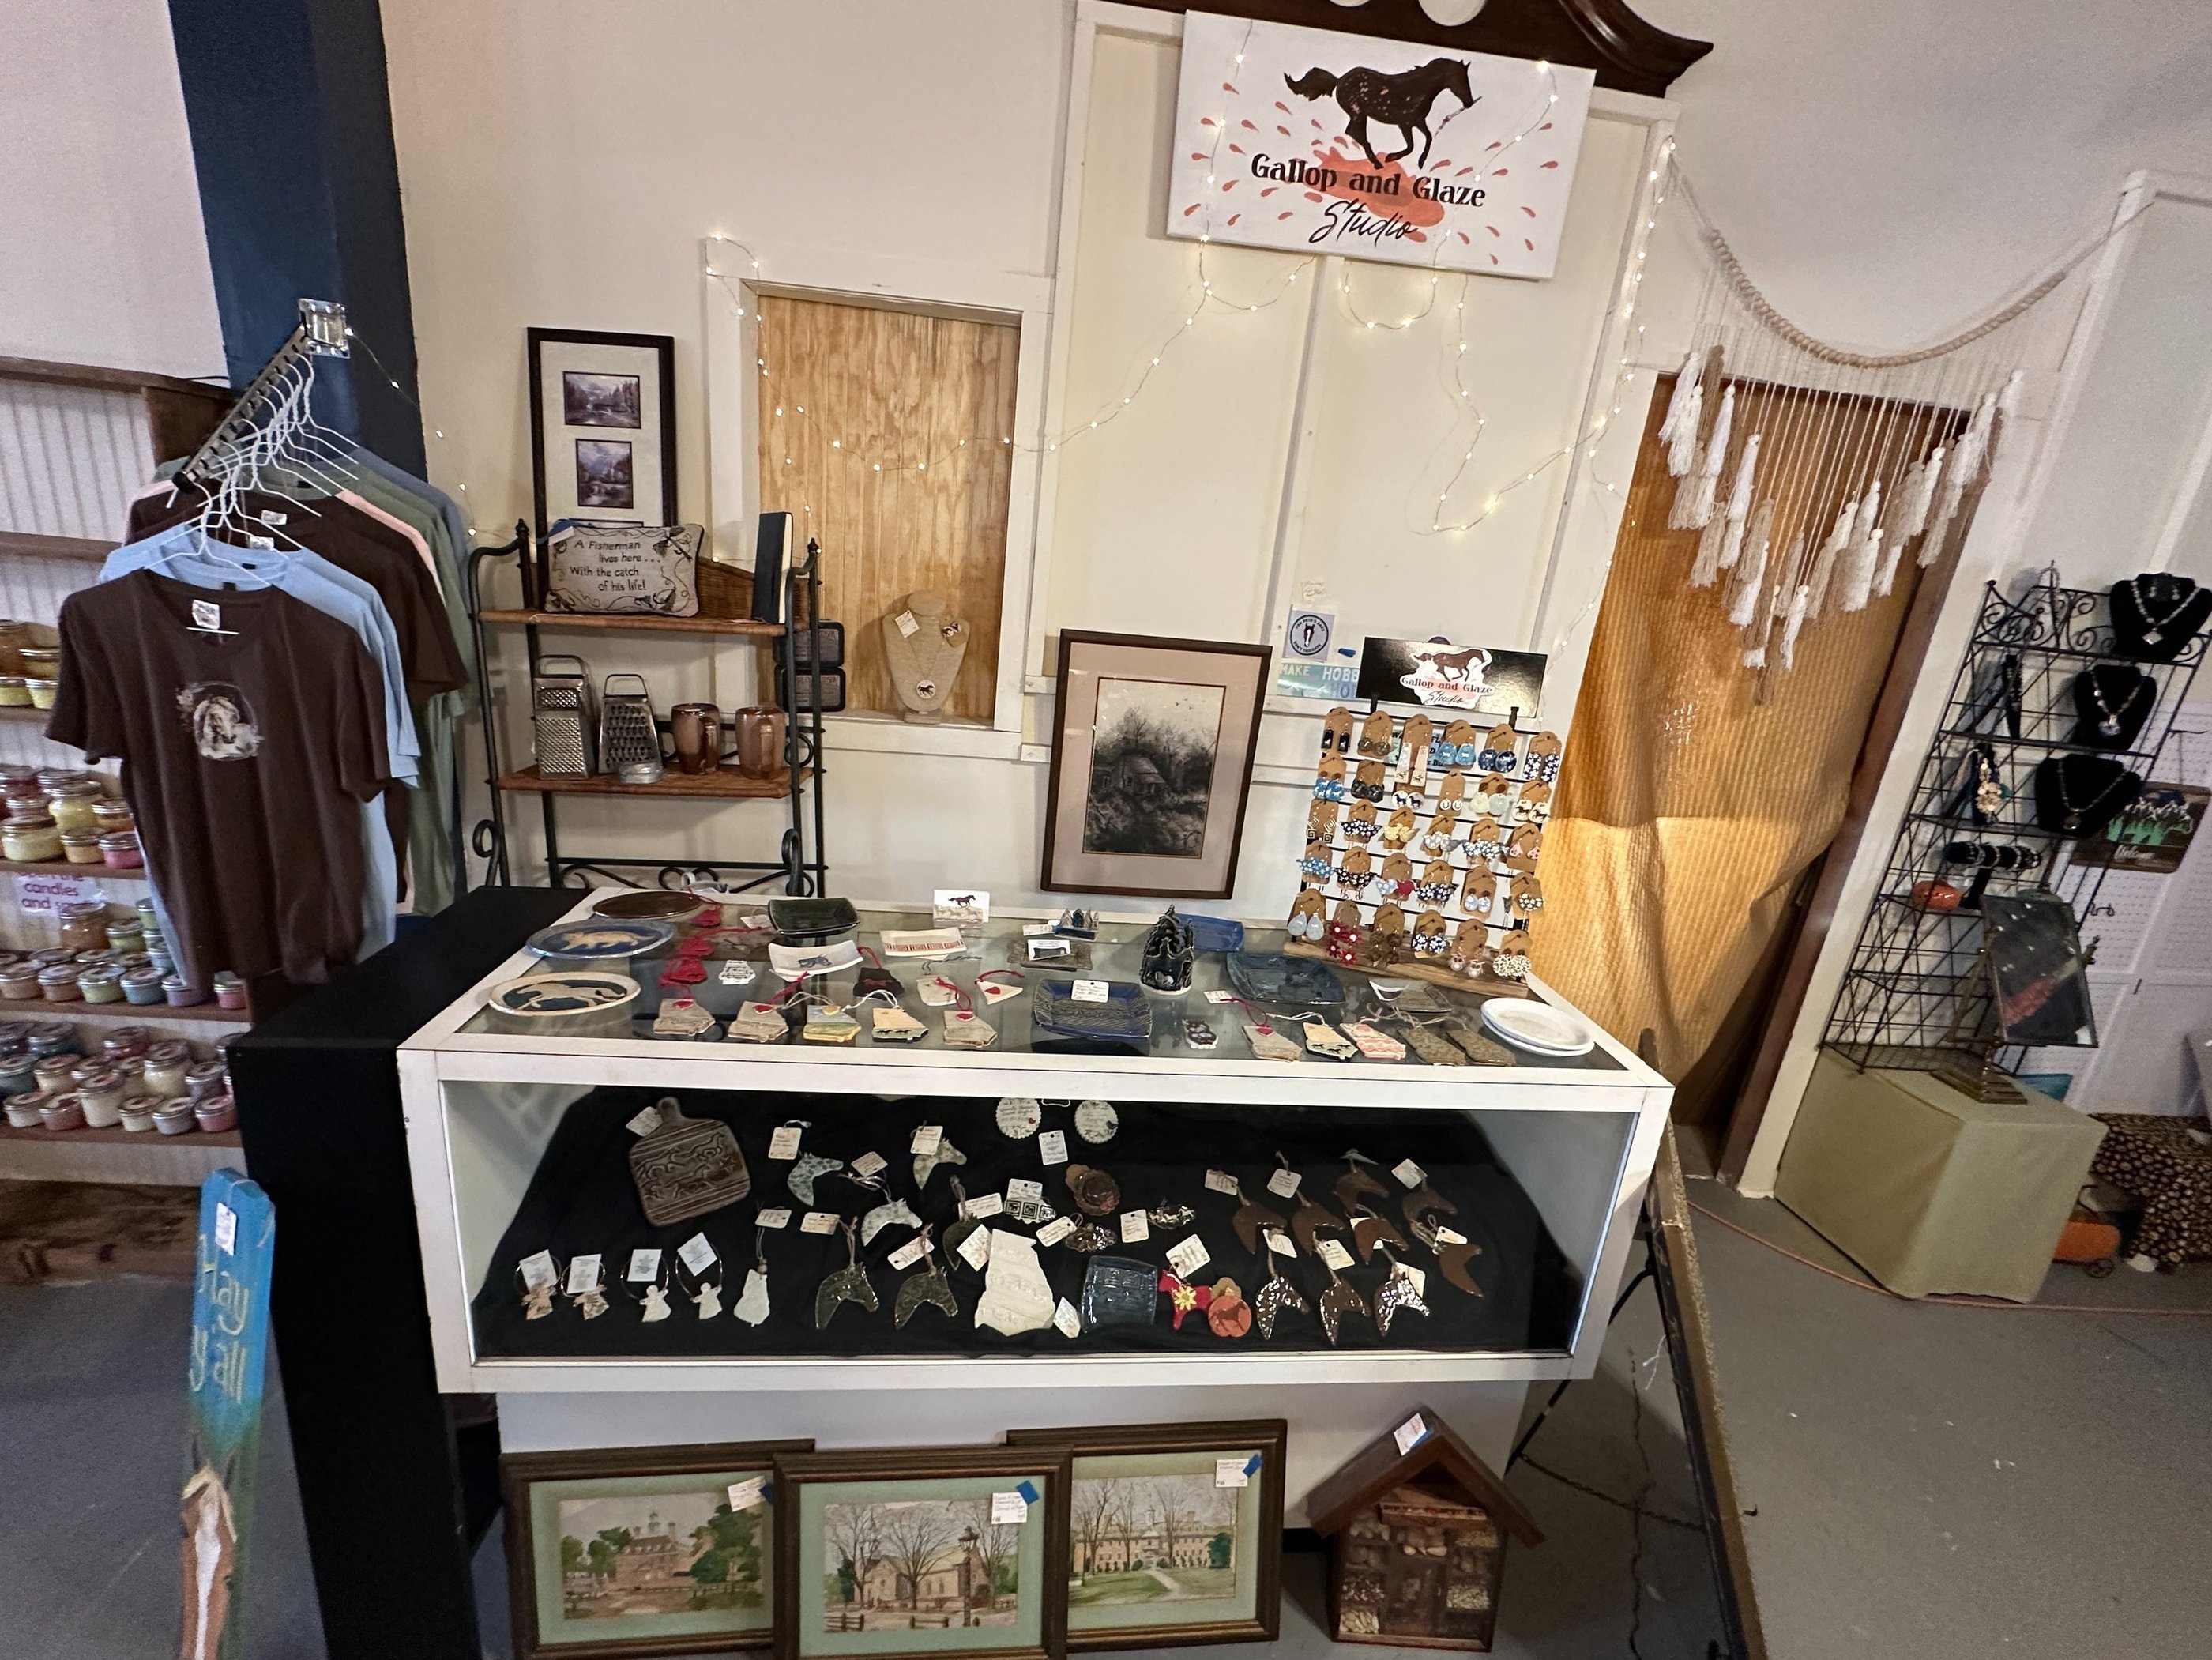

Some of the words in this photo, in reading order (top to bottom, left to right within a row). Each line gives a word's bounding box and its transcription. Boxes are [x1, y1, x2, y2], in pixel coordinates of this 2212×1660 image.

[1251, 153, 1337, 189] Gallop
[1349, 171, 1401, 197] and
[1412, 176, 1487, 208] Glaze
[1308, 200, 1420, 247] Studio
[574, 540, 585, 549] A
[588, 540, 641, 551] Fisherman
[599, 554, 619, 563] lives
[570, 565, 593, 577] With
[596, 566, 612, 578] the
[615, 567, 640, 578] catch
[598, 580, 610, 592] of
[611, 580, 626, 591] his
[628, 579, 647, 591] life!
[1281, 663, 1311, 676] MAKE
[1322, 666, 1360, 683] HOBB
[1401, 677, 1434, 688] Gallop
[1438, 683, 1458, 691] and
[1463, 683, 1493, 694] Glaze
[1423, 690, 1465, 706] Studio
[24, 882, 80, 897] candles
[21, 896, 51, 909] and
